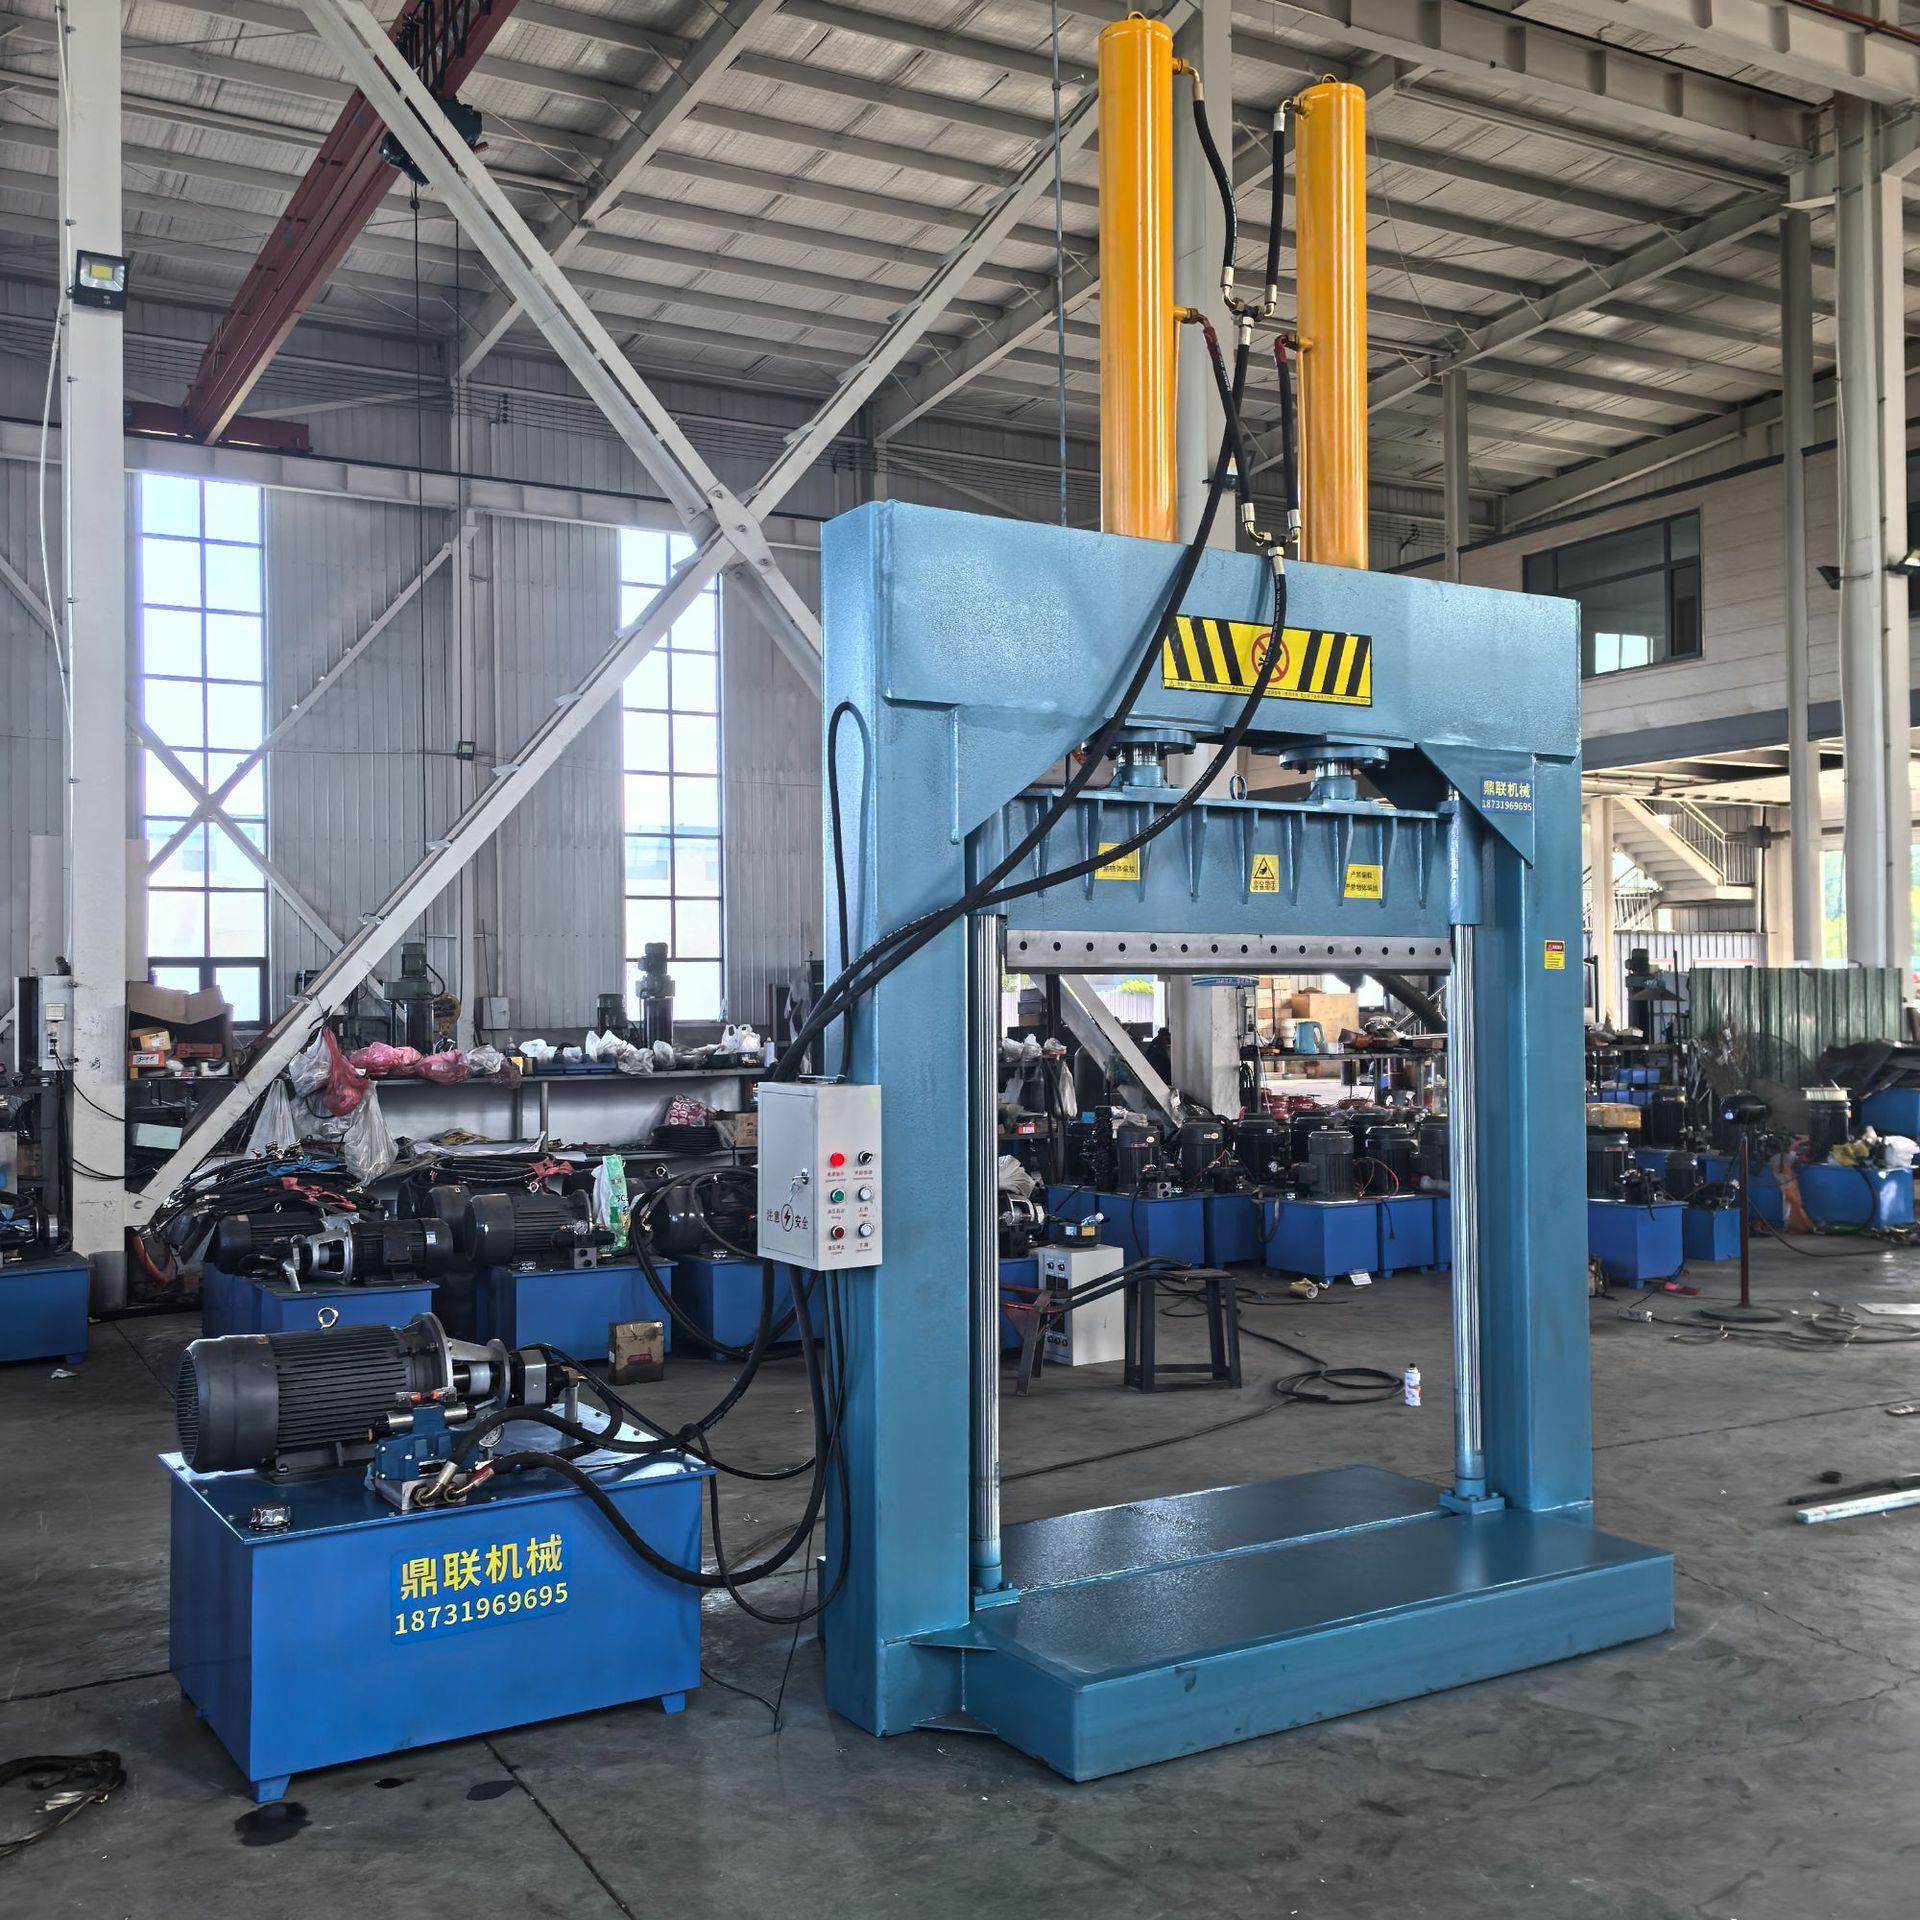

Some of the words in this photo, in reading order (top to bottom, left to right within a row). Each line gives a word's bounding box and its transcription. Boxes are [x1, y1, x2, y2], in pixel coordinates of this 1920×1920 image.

[1483, 780, 1531, 798] 鼎联机械
[1482, 800, 1532, 811] 18731969695
[795, 1214, 809, 1230] 安全
[401, 1533, 563, 1601] 鼎联机械
[395, 1582, 568, 1636] 18731969695
